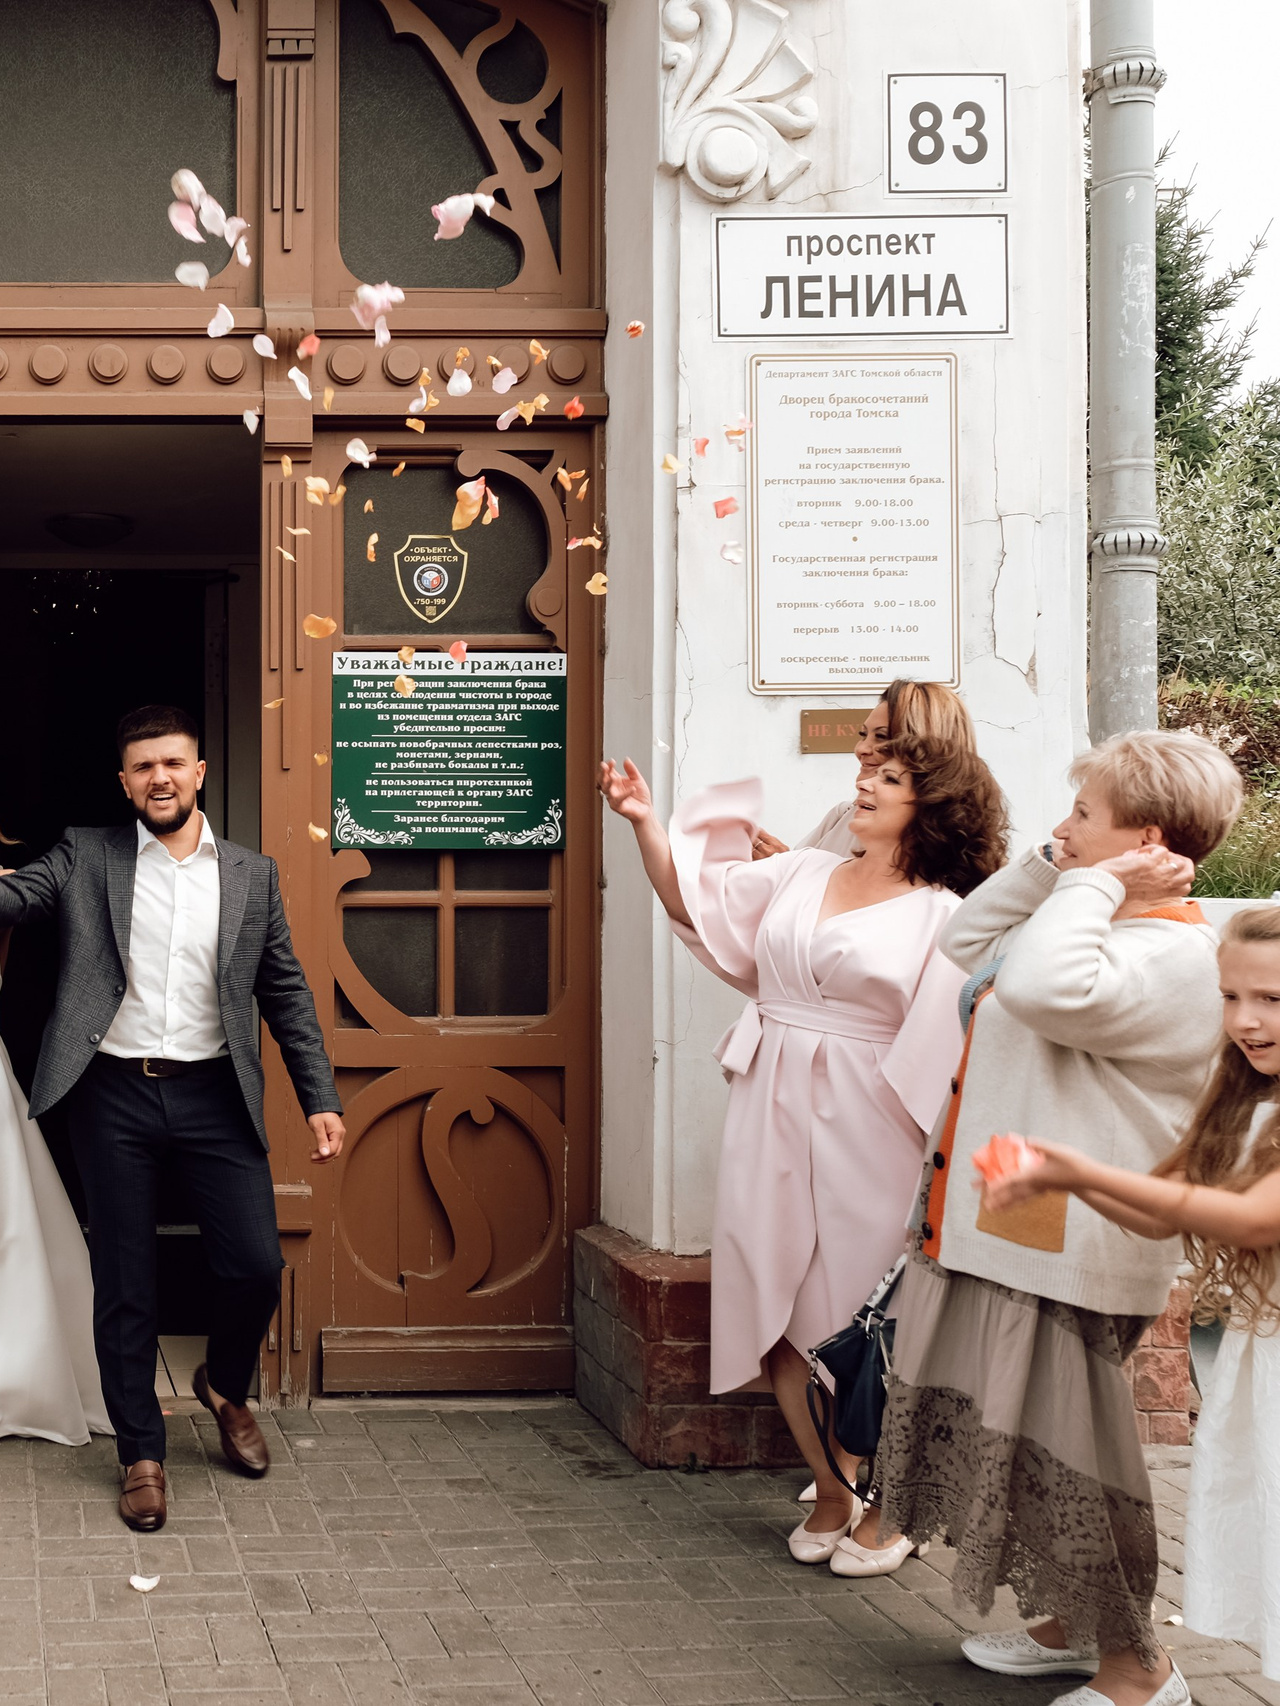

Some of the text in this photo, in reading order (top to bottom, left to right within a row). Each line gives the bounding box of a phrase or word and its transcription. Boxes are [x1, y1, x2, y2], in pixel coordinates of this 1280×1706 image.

[908, 101, 988, 165] 83
[787, 233, 935, 264] проспект
[760, 273, 967, 319] ЛЕНИНА
[765, 368, 943, 380] Департамент ЗАГС Томской области
[779, 393, 928, 407] Дворец бракосочетаний
[810, 408, 899, 421] города Томска
[807, 446, 902, 456] Прием заявлений
[815, 462, 910, 471] государственную
[764, 478, 836, 487] регистрацию
[909, 475, 945, 486] брака.
[797, 501, 842, 509] вторник
[779, 521, 810, 529] среда
[821, 520, 863, 529] четверг
[773, 554, 938, 564] Государственная регистрация
[872, 567, 908, 578] брака:
[909, 599, 936, 607] 18.00
[793, 627, 840, 635] перерыв
[851, 625, 879, 633] 13.00
[336, 656, 563, 673] Уважаемые граждане!
[781, 656, 849, 664] воскресенье
[829, 665, 883, 674] выходной
[353, 679, 374, 689] При
[377, 681, 445, 689] регации
[515, 679, 546, 690] брака
[390, 692, 456, 700] солюдения
[515, 692, 552, 701] городе
[365, 700, 424, 709] избежание
[426, 703, 495, 711] травматизма
[497, 703, 517, 712] при
[520, 703, 559, 711] выходе
[393, 714, 453, 722] помещения
[456, 714, 492, 722] отдела
[495, 713, 522, 721] ЗАГС
[393, 722, 506, 734] убедительно просим:
[808, 724, 831, 736] НЕ
[399, 739, 473, 749] новобрачных
[541, 742, 562, 750] роз,
[391, 760, 446, 770] разбивать
[448, 760, 489, 768] бокалы
[456, 779, 532, 788] пиротехникой
[381, 788, 455, 797] прилегающей
[466, 790, 504, 798] органу
[506, 788, 533, 796] ЗАГС
[416, 800, 482, 808] территории.
[394, 813, 505, 824] Заранее благодарим
